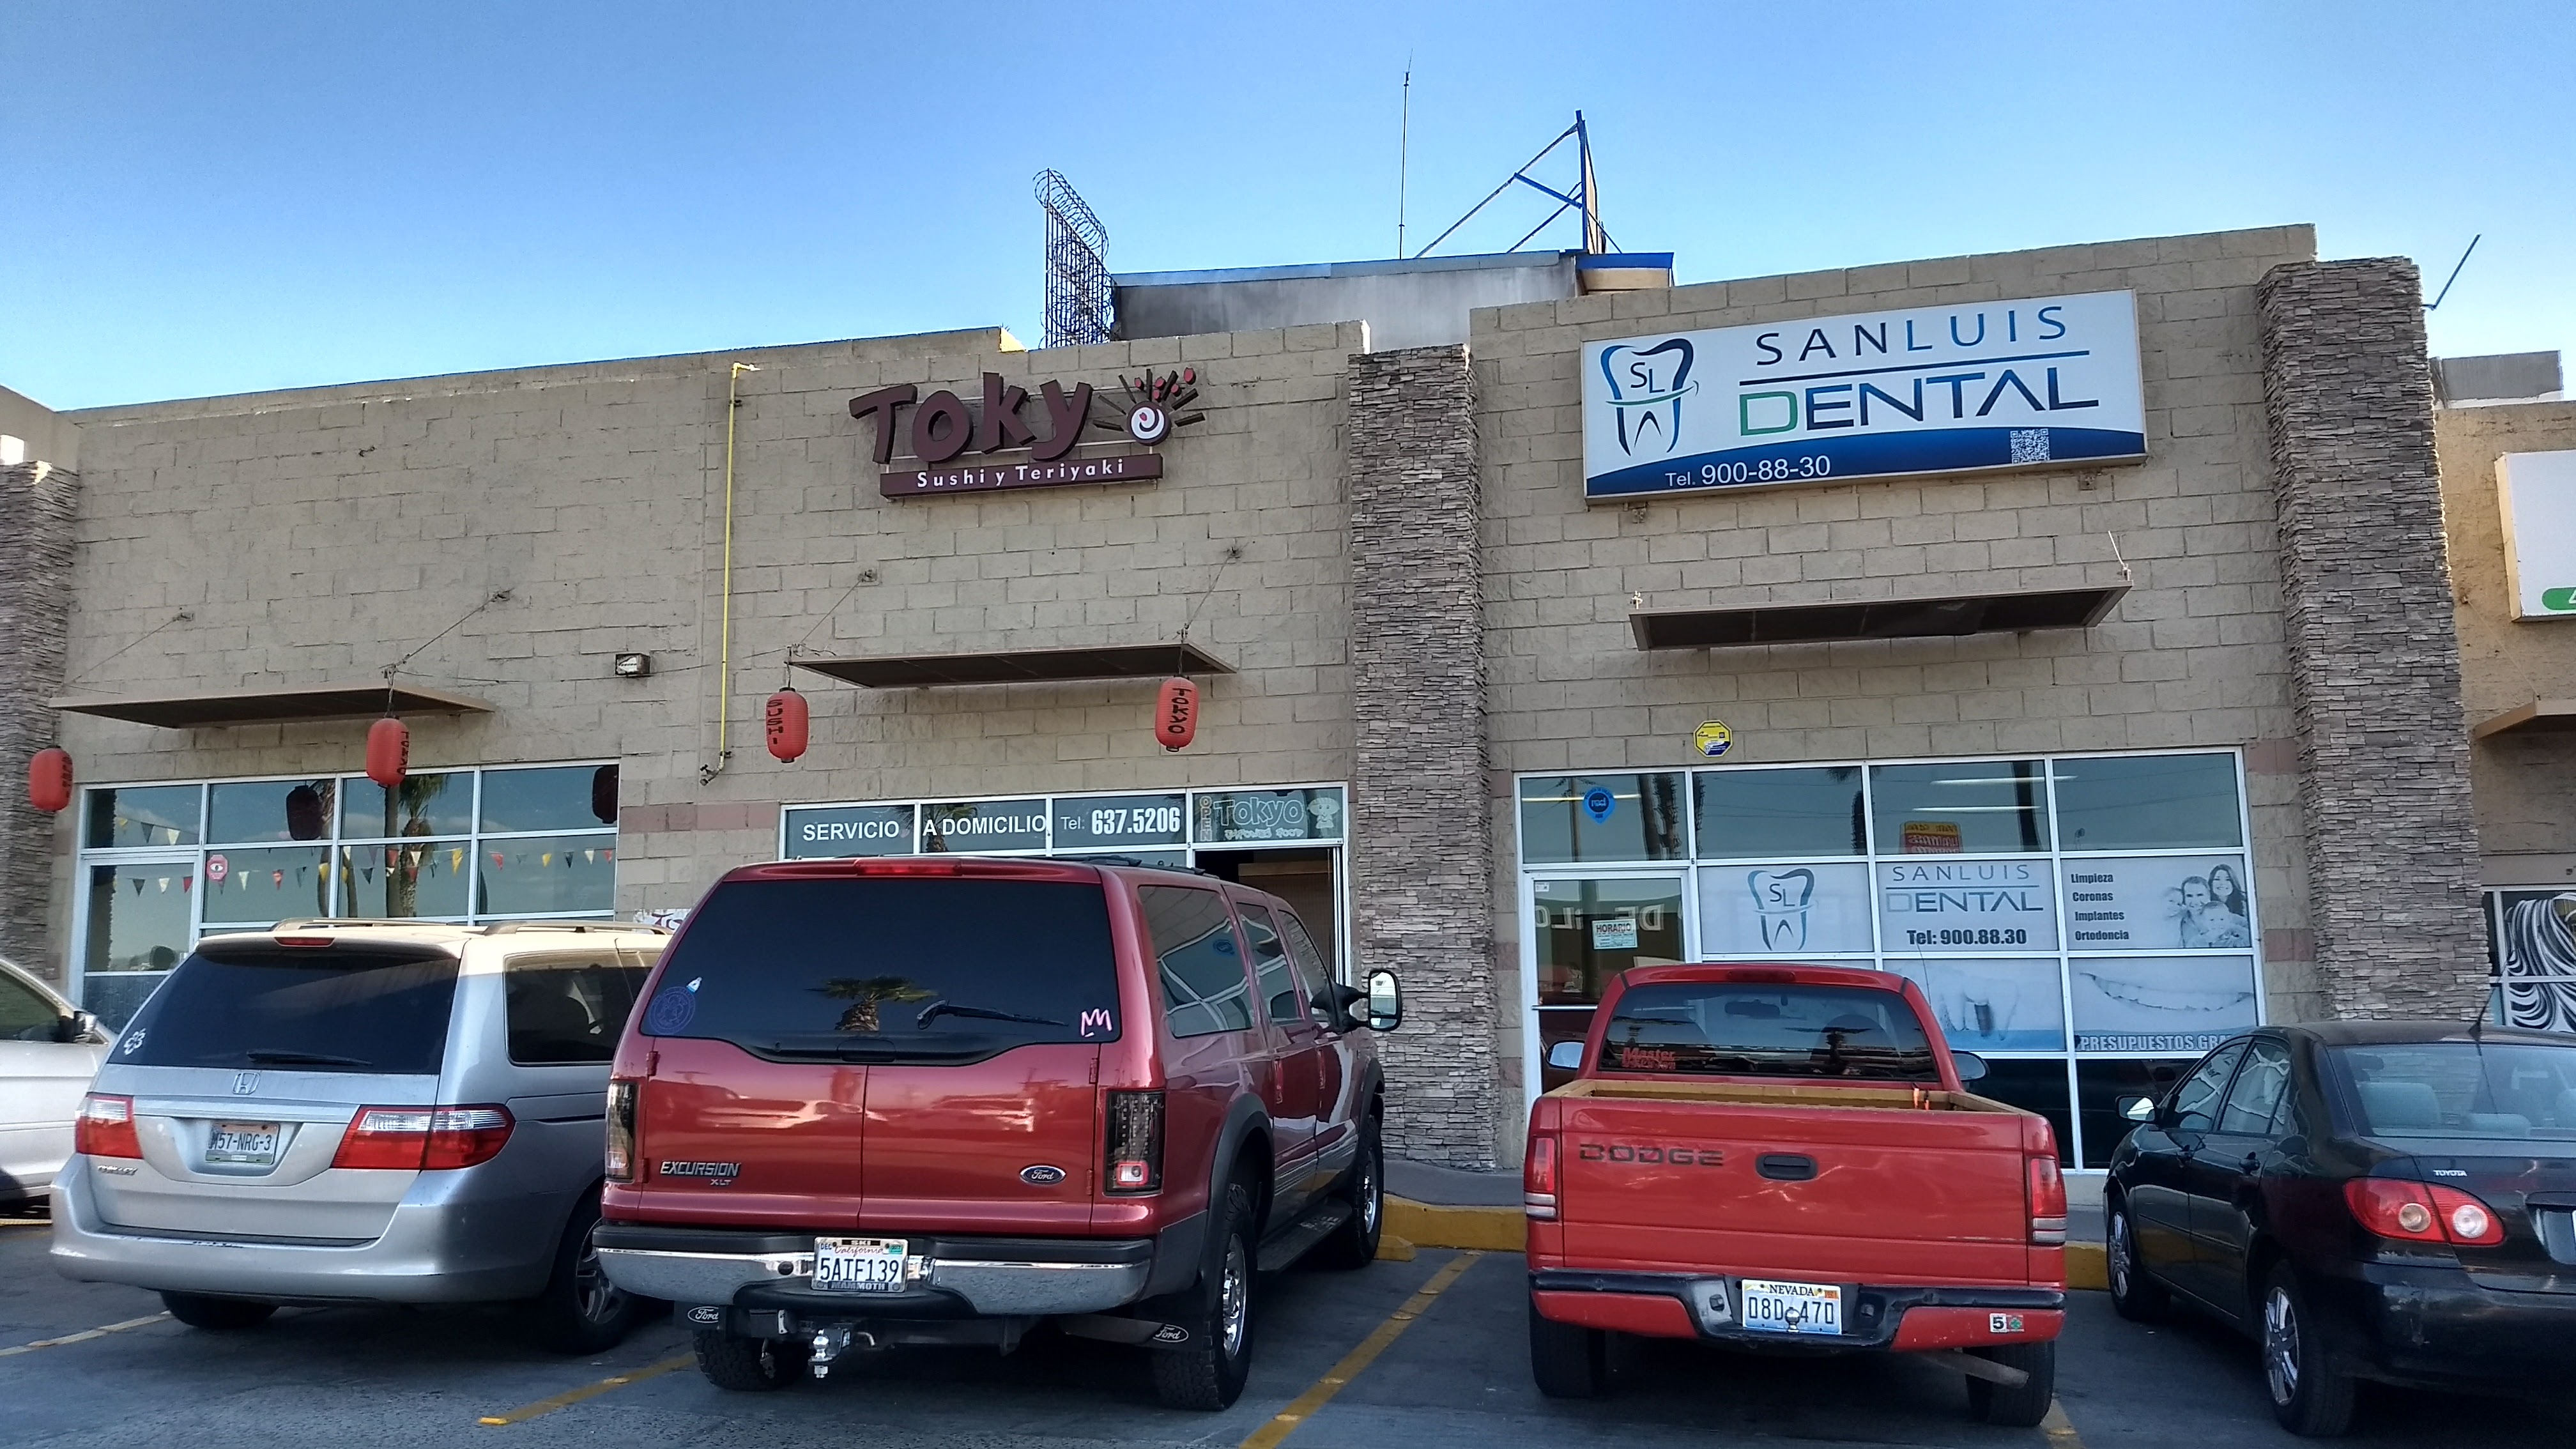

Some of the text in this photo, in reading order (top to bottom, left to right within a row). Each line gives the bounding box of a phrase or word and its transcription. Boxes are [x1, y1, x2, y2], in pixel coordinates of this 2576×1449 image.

[1756, 306, 2067, 366] SANLUIS
[1630, 362, 1665, 394] SL
[1739, 367, 2099, 436] DENTAL
[917, 458, 1124, 488] Sushi y Teriyaki
[1665, 455, 1831, 487] Tel. 900-88-30
[1167, 687, 1192, 734] TOKYO
[767, 699, 784, 745] SUSHI
[1091, 806, 1181, 835] 637.5206
[1199, 795, 1213, 841] OPEN
[802, 815, 1046, 841] SERVICIO A DOMICILIO
[1892, 864, 2030, 881] SANLUIS
[2071, 873, 2113, 884] Limpieza
[1769, 883, 1795, 907] SL
[1885, 891, 2044, 912] DENTAL
[2072, 892, 2113, 901] Coronas
[2074, 911, 2125, 921] Implantes
[1596, 923, 1631, 933] HORARIO
[1906, 928, 2027, 945] Tel: 900.88.30
[2075, 930, 2129, 941] Ortodoncia
[2079, 1034, 2195, 1052] PRESUPUESTOS
[1579, 1143, 1724, 1167] DODGE
[660, 1161, 740, 1176] EXCURSION
[1031, 1169, 1055, 1180] Ford
[834, 1246, 888, 1257] California
[820, 1257, 900, 1283] 5AIF139
[831, 1282, 885, 1290] MAMMOTH
[1768, 1284, 1815, 1296] NEVADA
[694, 1308, 719, 1320] Ford
[1800, 1300, 1834, 1324] 470
[1993, 1317, 2004, 1330] 5
[1154, 1326, 1181, 1340] Ford
